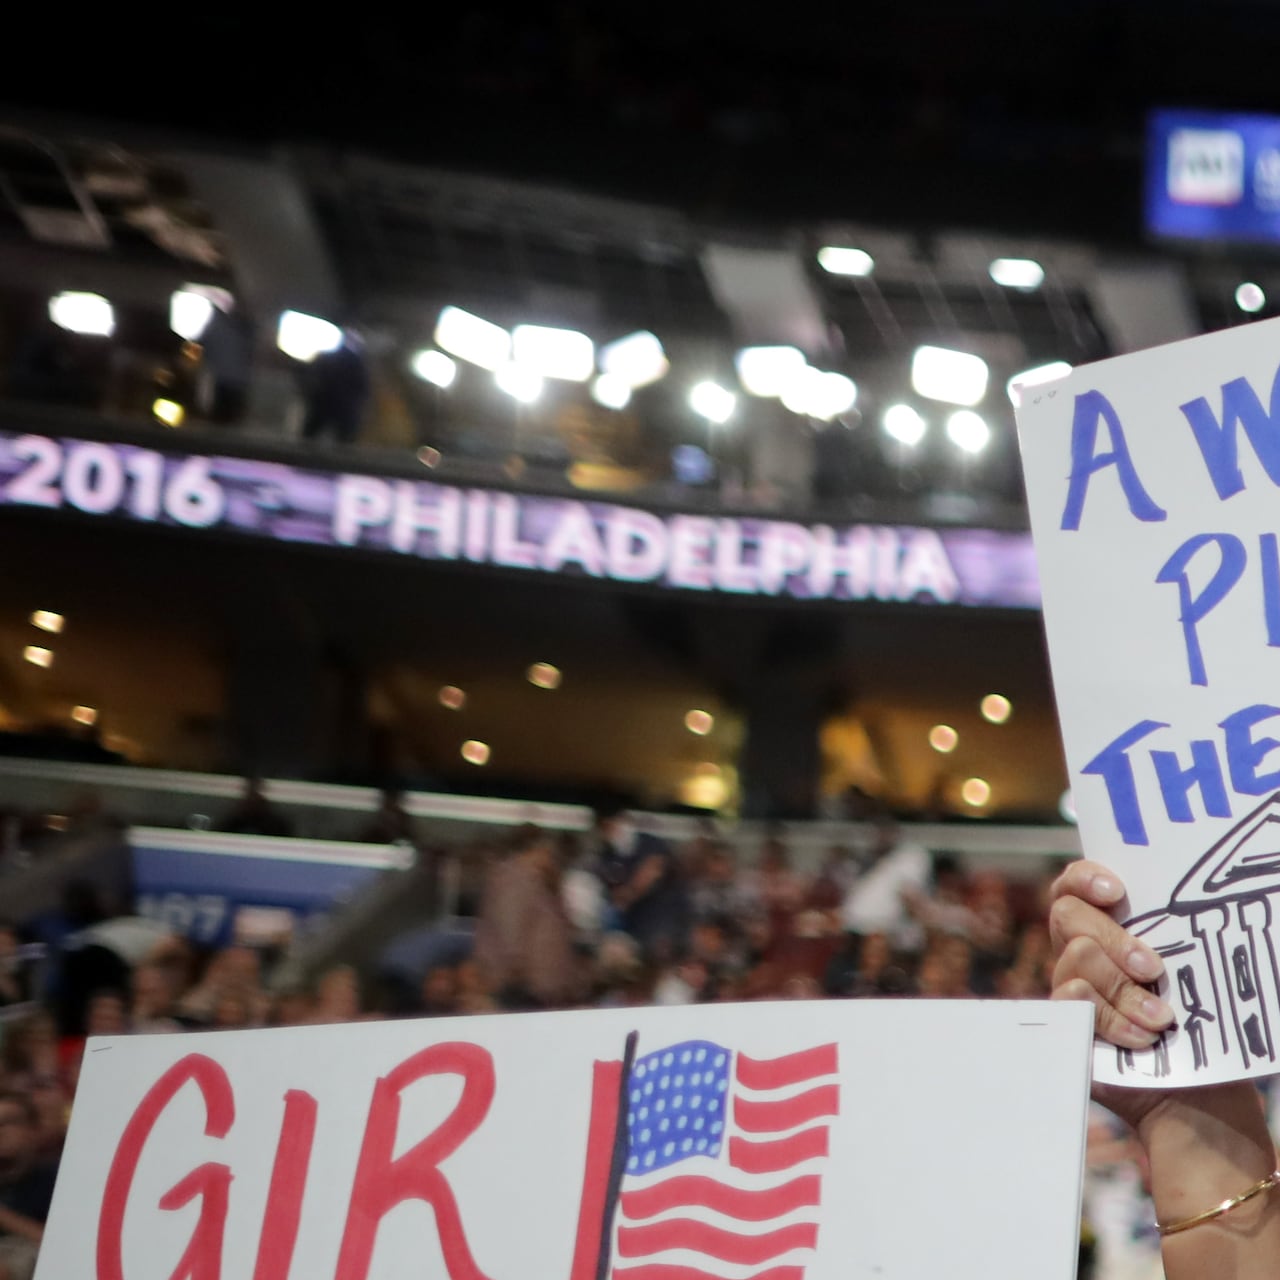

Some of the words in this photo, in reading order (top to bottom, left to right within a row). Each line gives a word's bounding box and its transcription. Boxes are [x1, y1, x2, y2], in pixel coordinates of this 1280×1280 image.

[4, 434, 226, 529] 2016
[333, 474, 959, 600] PHILADELPHIA
[1061, 388, 1166, 531] A
